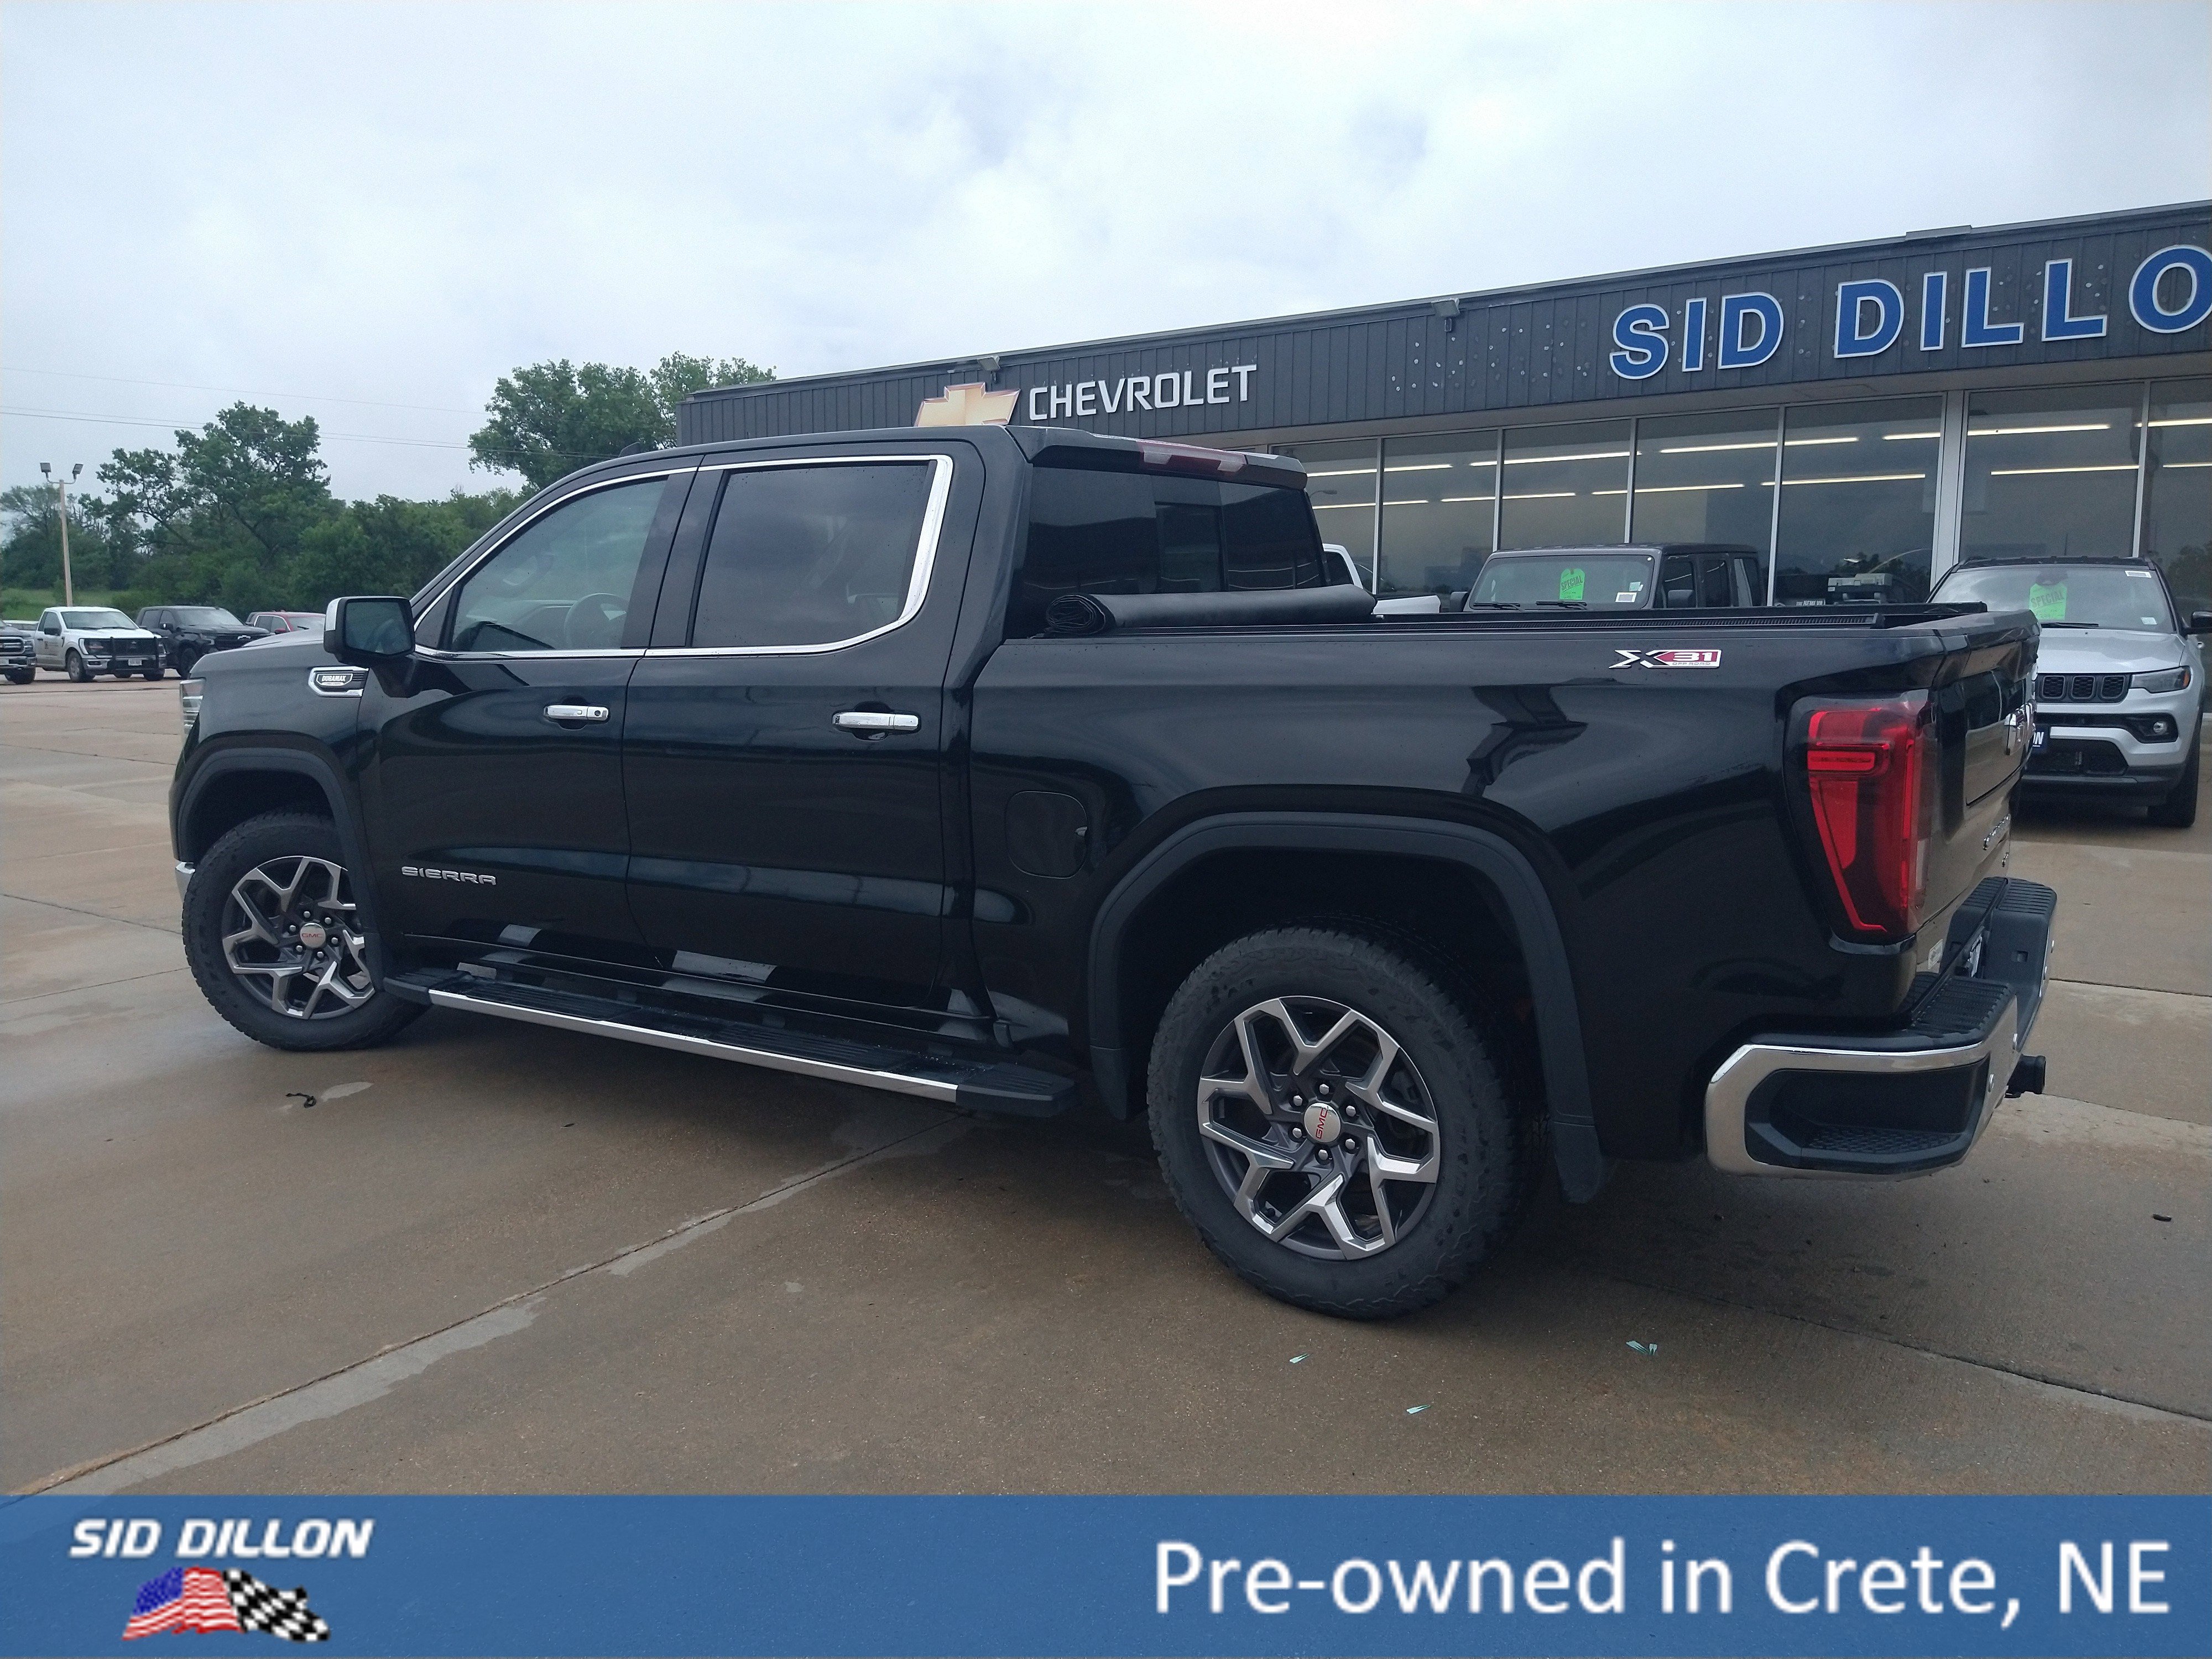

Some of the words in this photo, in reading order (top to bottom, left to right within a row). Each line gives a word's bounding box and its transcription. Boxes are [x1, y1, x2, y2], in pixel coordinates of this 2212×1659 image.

[1609, 291, 1785, 380] SID
[1833, 244, 2212, 359] DILLO
[1029, 363, 1258, 421] CHEVROLET
[1561, 575, 1583, 591] SPECIAL
[2031, 590, 2065, 608] SPECIAL
[1608, 649, 1721, 669] X31
[401, 866, 497, 885] SIERRA
[1316, 1107, 1328, 1139] GMC
